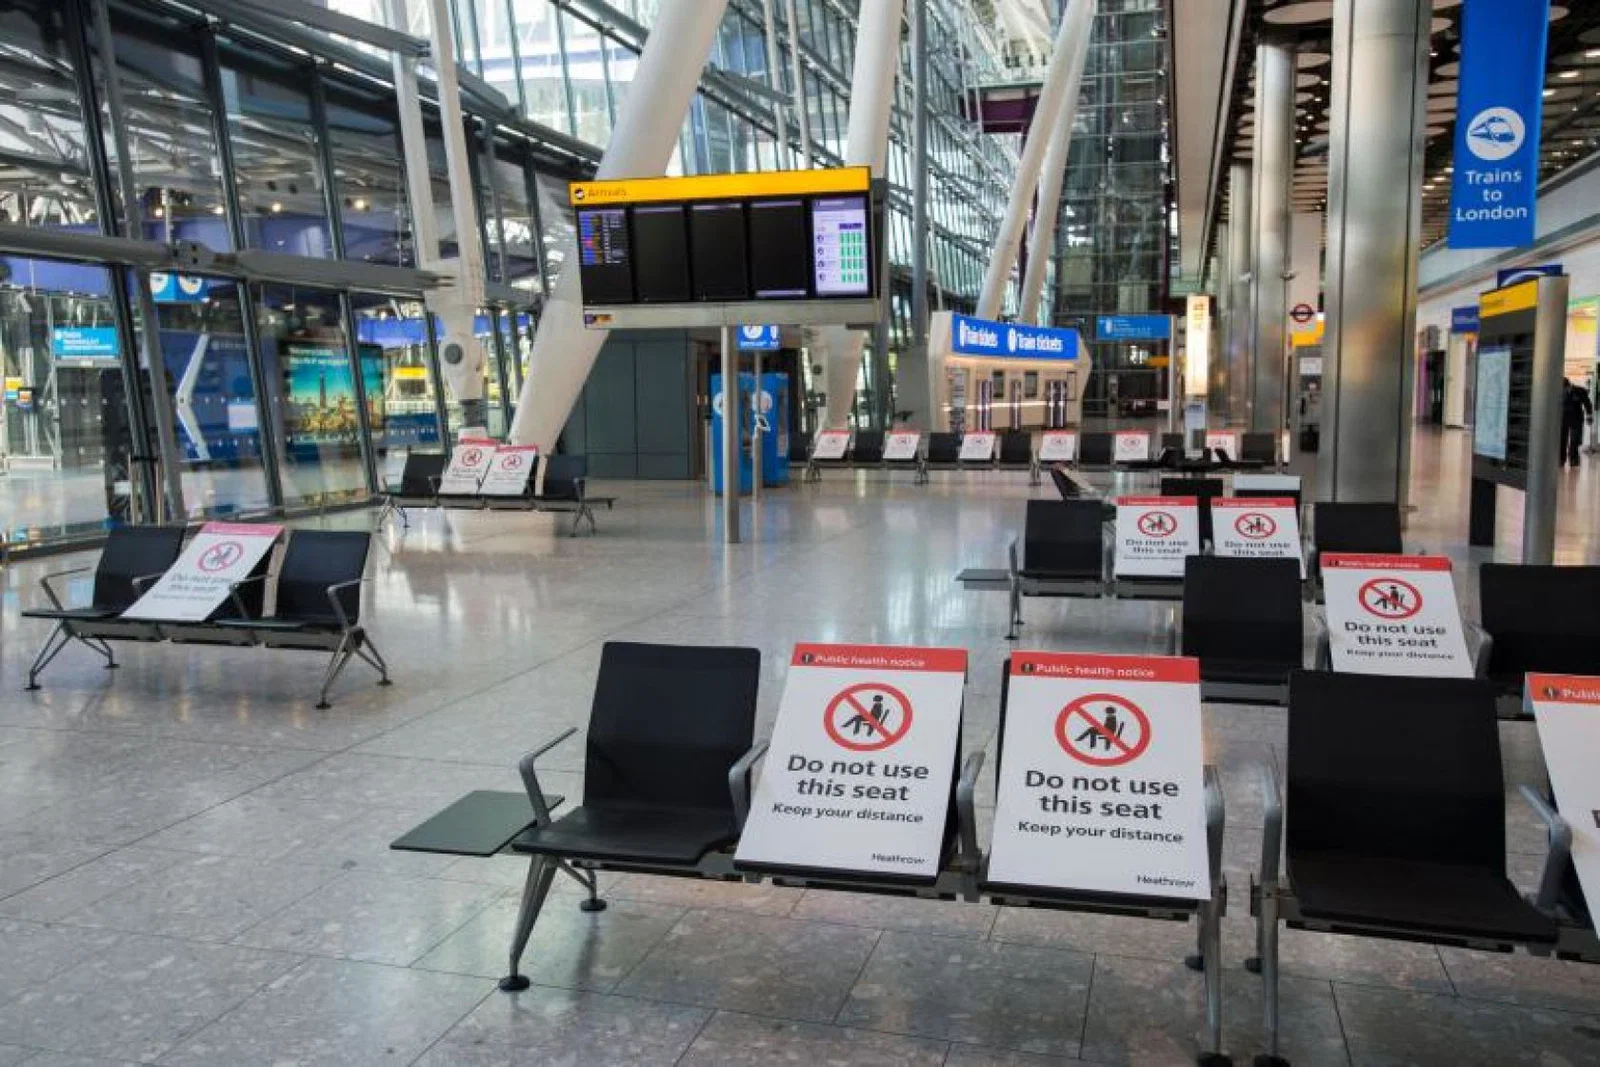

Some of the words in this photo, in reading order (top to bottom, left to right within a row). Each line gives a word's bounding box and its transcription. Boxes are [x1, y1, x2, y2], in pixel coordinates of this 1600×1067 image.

[1465, 167, 1522, 185] Trains
[1483, 189, 1502, 202] to
[1455, 205, 1528, 222] London
[1017, 332, 1036, 350] Train
[1036, 333, 1063, 352] tickets
[1344, 621, 1371, 632] Do
[1376, 623, 1409, 635] not
[1413, 625, 1447, 635] use
[1358, 635, 1392, 646] this
[1397, 637, 1439, 648] seat
[815, 655, 849, 665] Public
[851, 656, 889, 666] health
[890, 658, 926, 668] notice
[1406, 651, 1455, 660] distance
[1036, 663, 1073, 675] Public
[1074, 666, 1114, 677] health
[1117, 667, 1156, 678] notice
[787, 754, 824, 773] Do
[830, 759, 877, 777] not
[883, 764, 930, 780] use
[797, 778, 846, 797] this
[852, 785, 910, 801] seat
[1025, 770, 1064, 789] Do
[1072, 775, 1121, 793] not
[1129, 780, 1180, 797] use
[772, 802, 813, 818] Keep
[815, 807, 854, 819] your
[856, 809, 924, 823] distance
[1039, 794, 1093, 815] this
[1101, 801, 1163, 820] seat
[1018, 821, 1062, 837] Keep
[1066, 826, 1107, 838] your
[1109, 827, 1184, 843] distance
[871, 852, 926, 864] Heathrow
[1137, 874, 1196, 888] Heathrow
